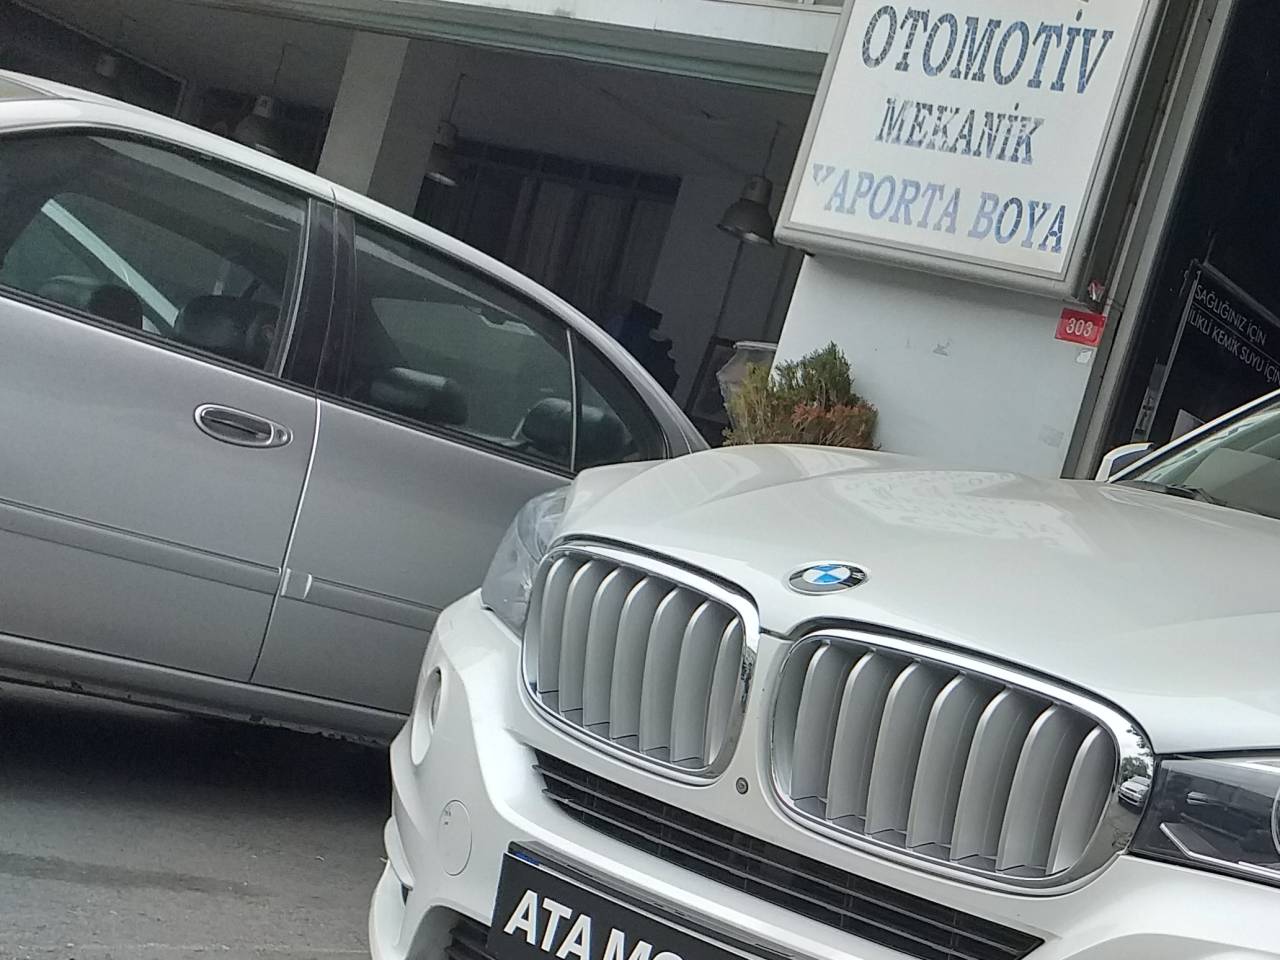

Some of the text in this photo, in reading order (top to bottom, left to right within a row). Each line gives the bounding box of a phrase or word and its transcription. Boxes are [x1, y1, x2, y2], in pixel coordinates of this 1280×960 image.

[862, 5, 1115, 94] OTOMOTİV
[875, 98, 1044, 165] MEKANİK
[967, 191, 1067, 254] BOYA
[1066, 318, 1093, 337] 303
